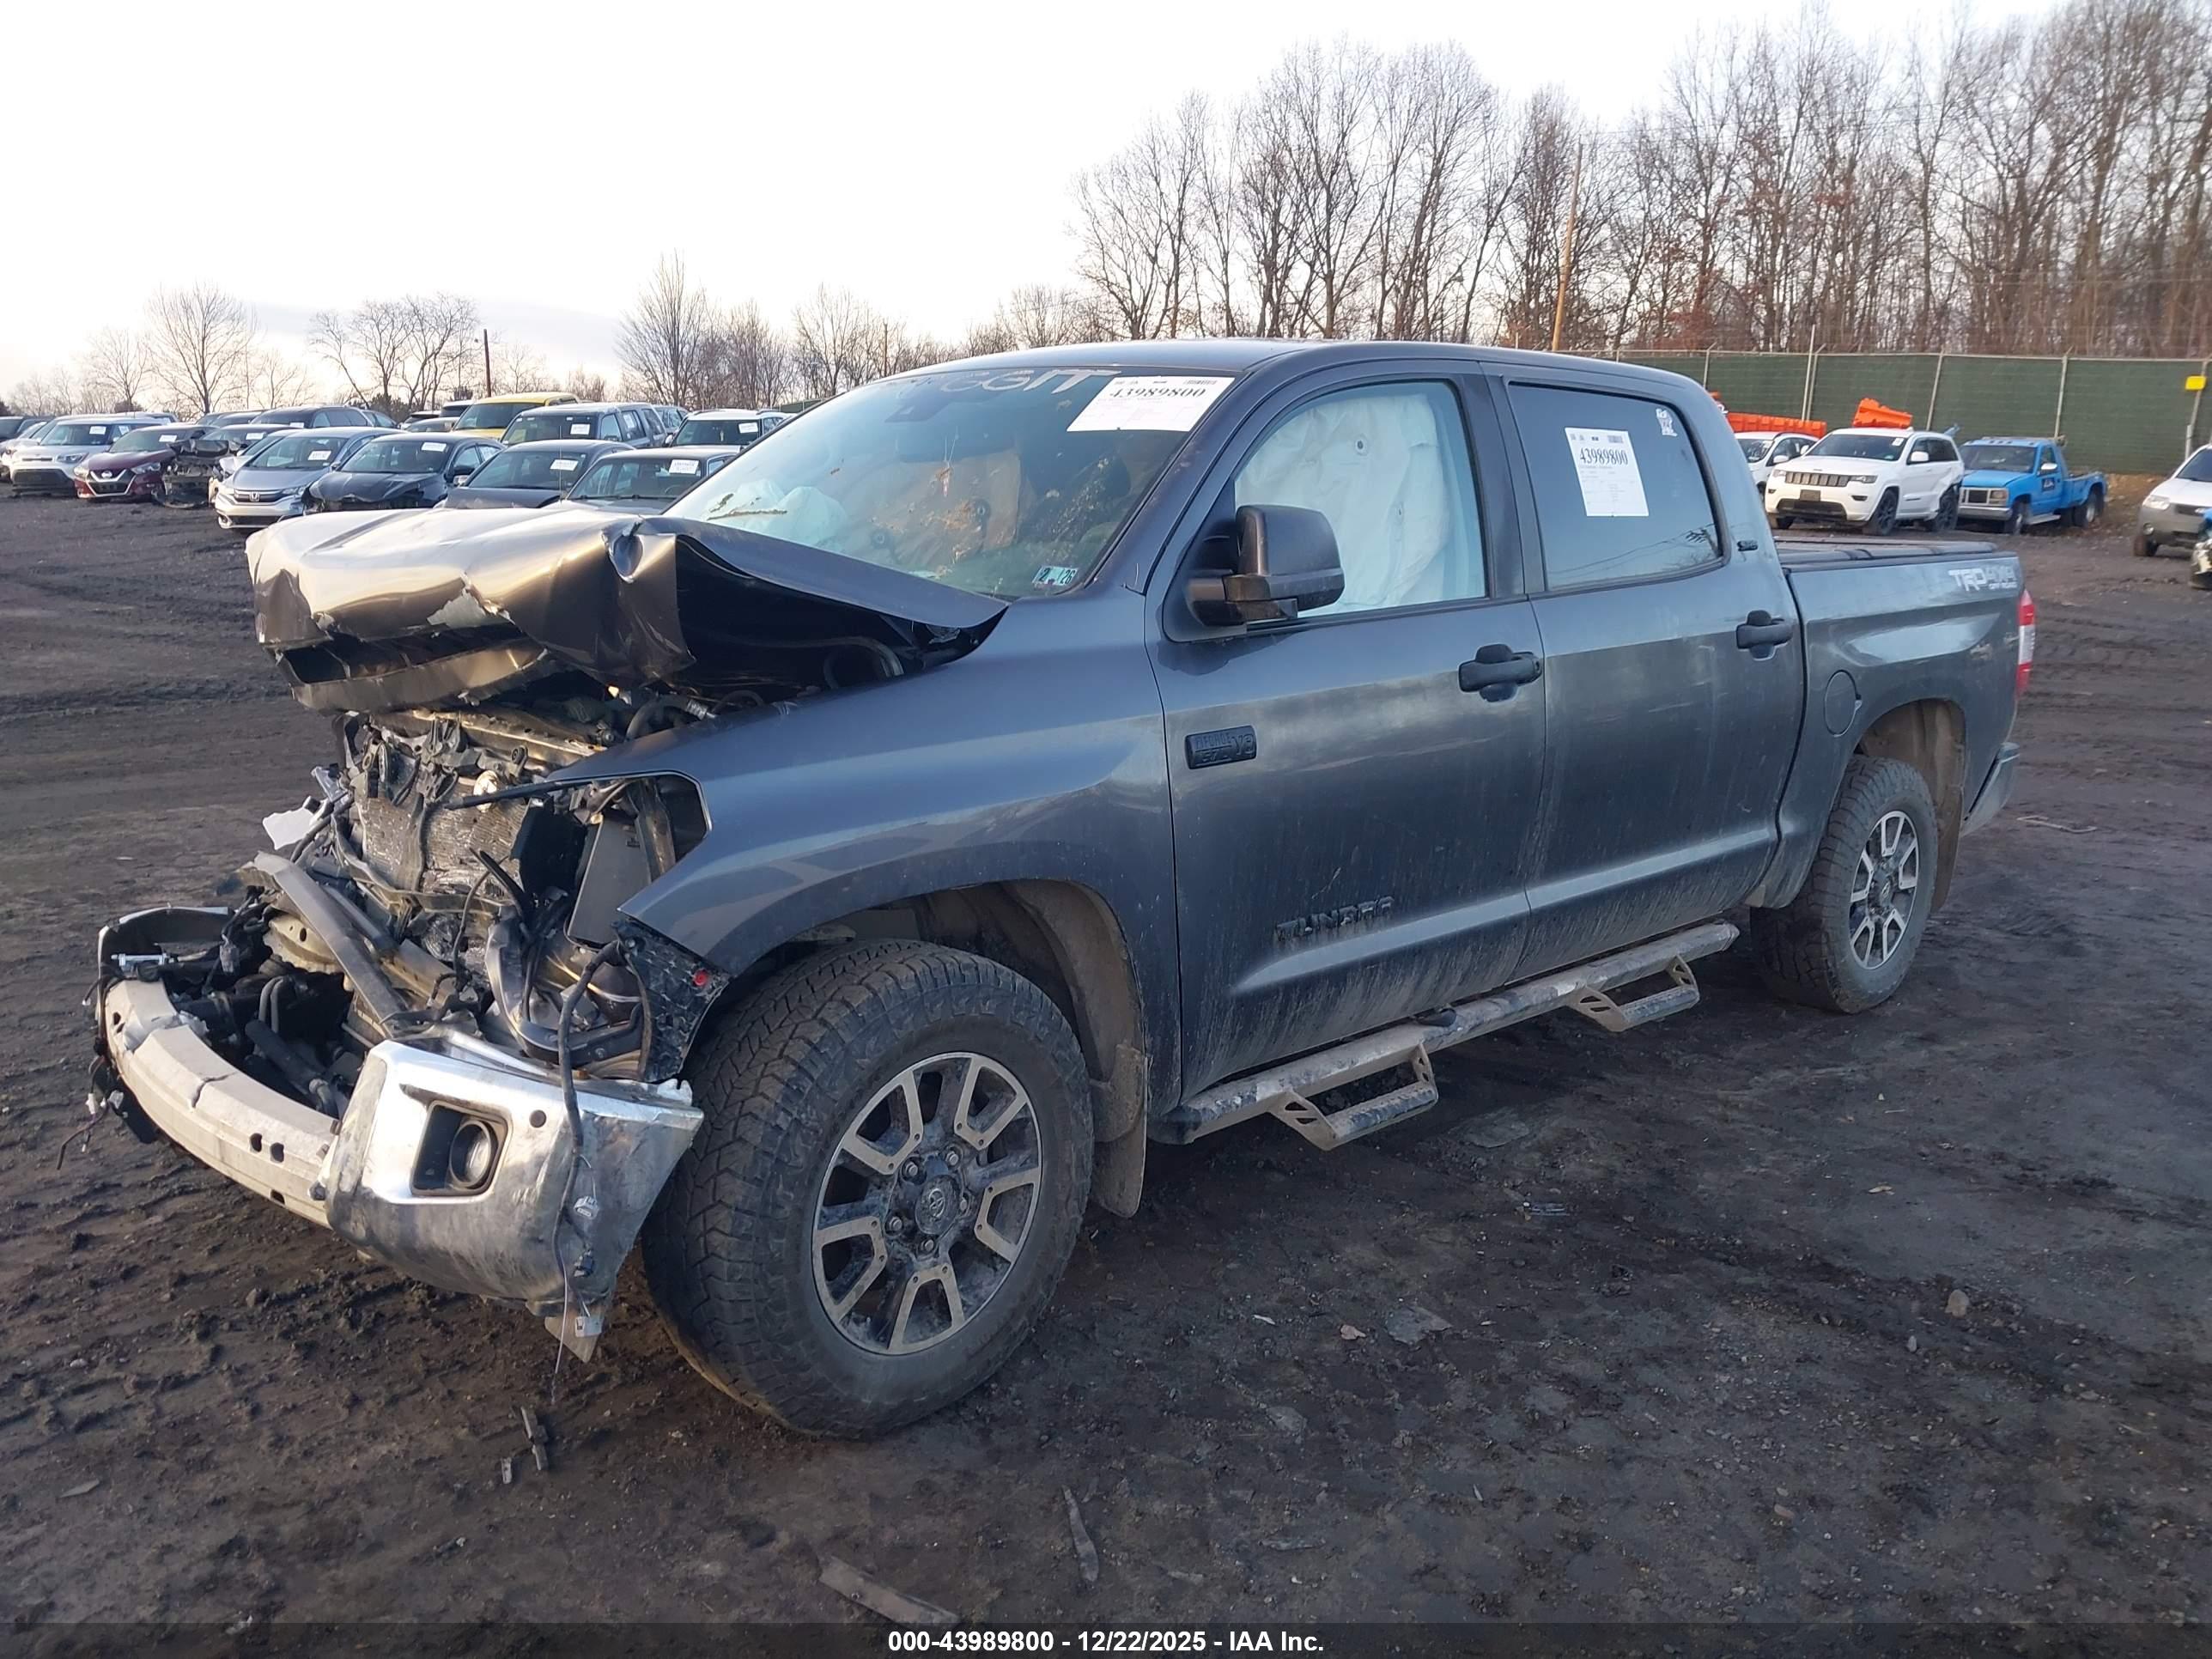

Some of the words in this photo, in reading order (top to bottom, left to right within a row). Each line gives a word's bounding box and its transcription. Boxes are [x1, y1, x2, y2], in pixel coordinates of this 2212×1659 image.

[1109, 387, 1206, 398] 43989800
[1579, 447, 1628, 465] 43989800
[1948, 568, 1987, 592] TRD
